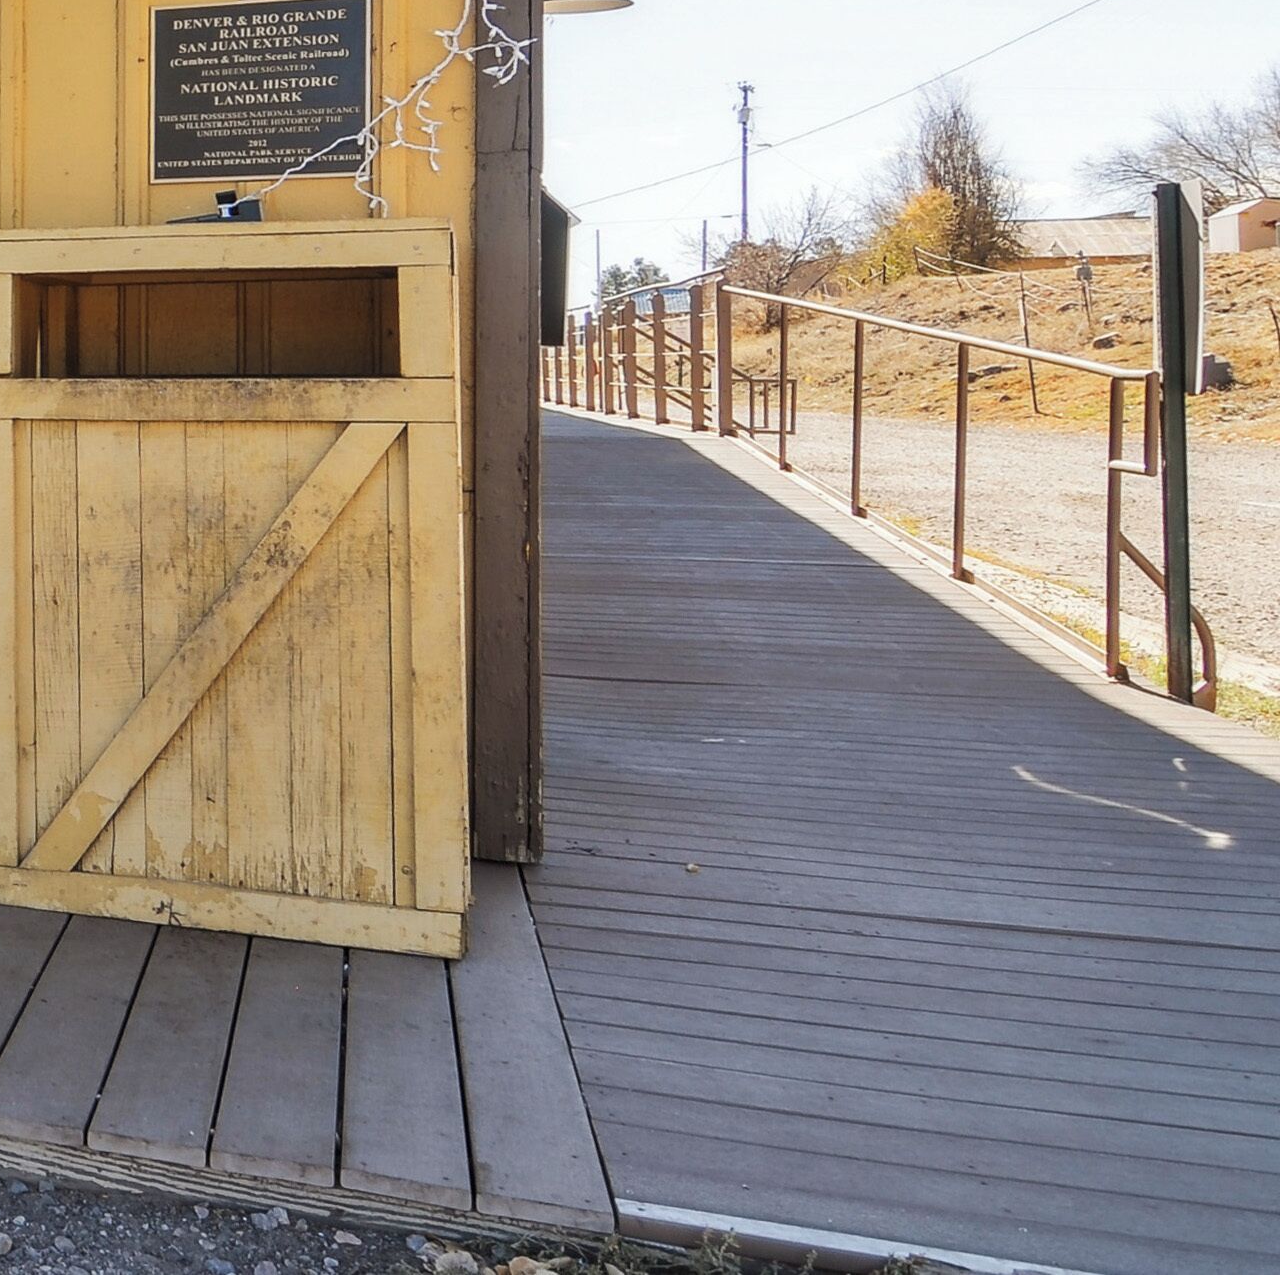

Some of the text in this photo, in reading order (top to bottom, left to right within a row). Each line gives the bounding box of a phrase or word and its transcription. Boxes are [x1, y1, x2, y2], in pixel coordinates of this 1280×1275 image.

[173, 8, 347, 30] DENVER & RIO GRANDE
[219, 25, 299, 39] RAILROAD
[178, 34, 340, 54] SAN JUAN EXTENSION
[170, 48, 350, 68] (Cumbres & Toltec Scenic Railroad)
[201, 69, 220, 77] HAS
[222, 67, 246, 76] BEEN
[248, 64, 307, 74] DESIGNATED
[180, 75, 339, 95] NATIONAL HISTORIC
[214, 91, 303, 106] LANDMARK
[159, 106, 360, 123] THIS SITE POSSESSES NATIONAL SIGNIFICANCE
[175, 114, 343, 130] IN ILLUSTRATING THE HISTORY OF THE
[197, 123, 320, 137] UNITED STATES OF AMERICA
[248, 138, 267, 147] 2012
[204, 146, 312, 158] NATIONAL PARK SERVICE
[191, 159, 222, 167] STATES
[224, 156, 281, 165] DEPARTMENT
[318, 153, 361, 162] INTERIOR
